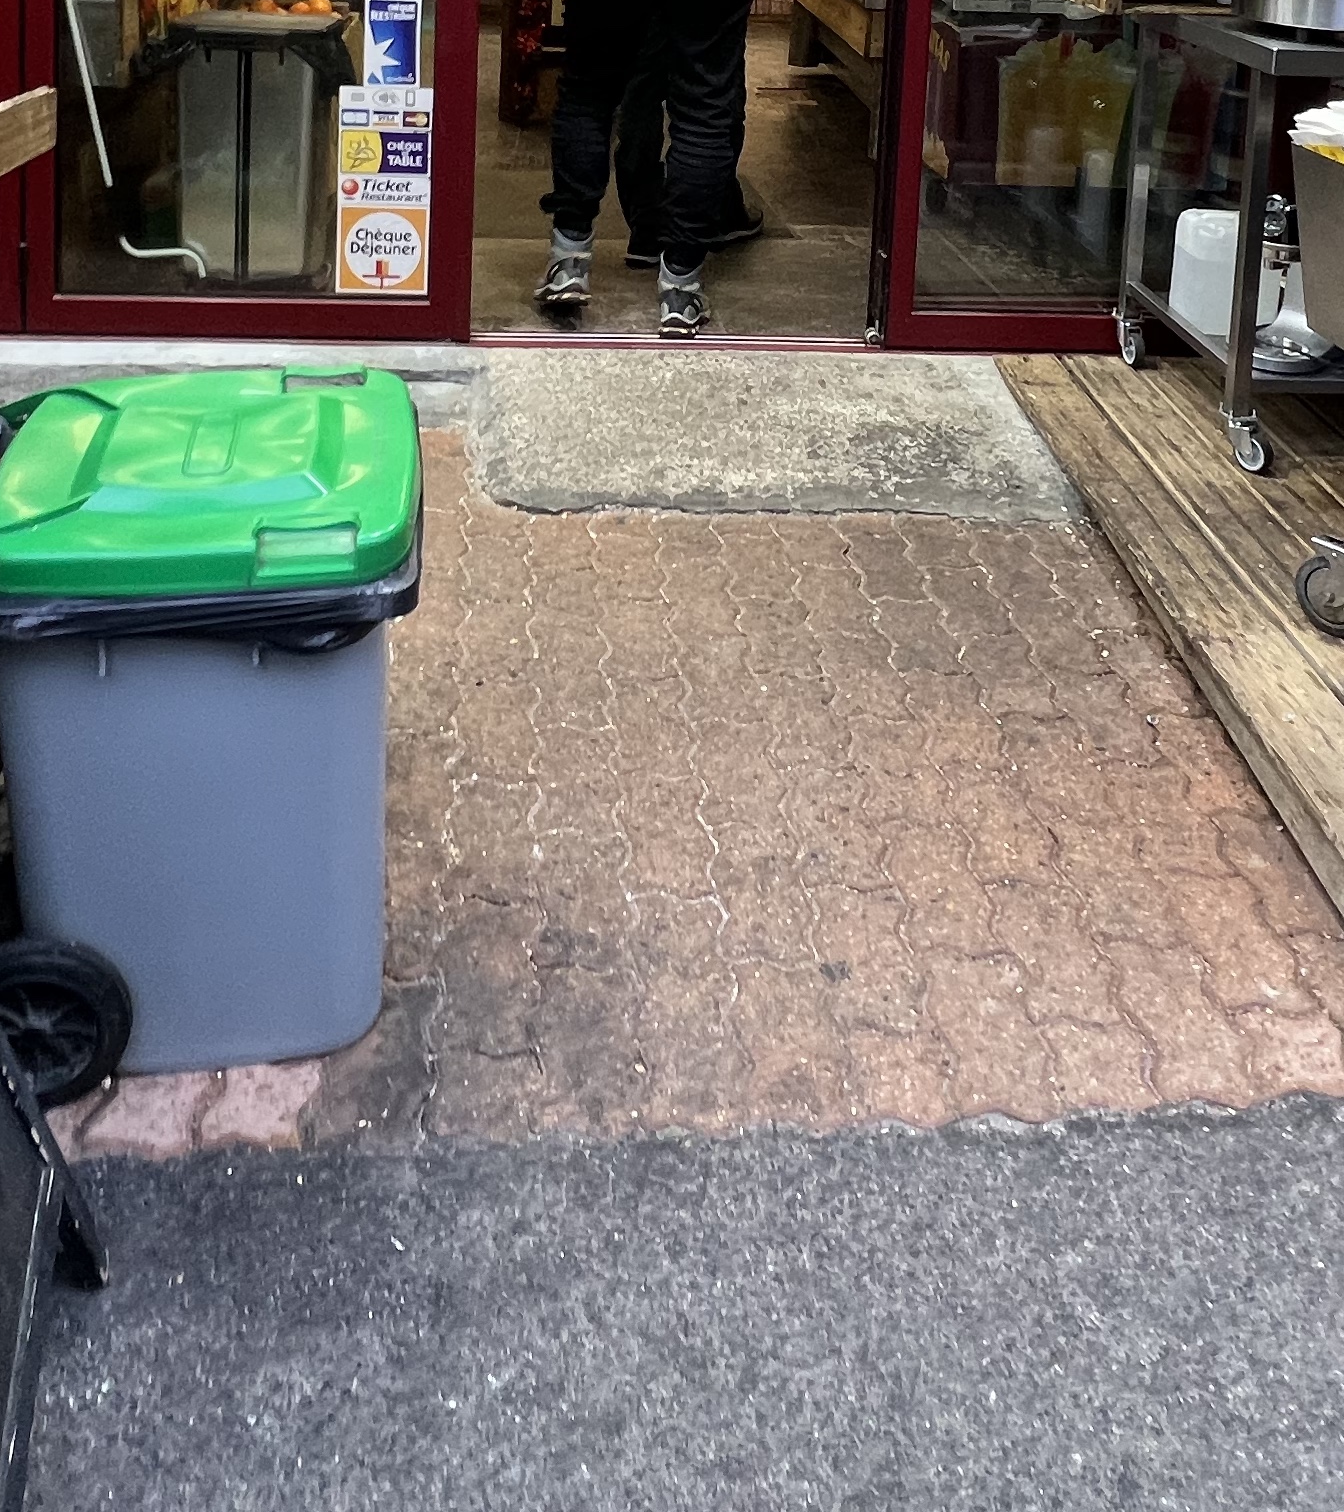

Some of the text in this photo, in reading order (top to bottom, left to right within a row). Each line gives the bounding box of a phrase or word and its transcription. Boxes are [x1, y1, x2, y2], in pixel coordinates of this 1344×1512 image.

[386, 154, 423, 167] TABLE
[362, 178, 414, 193] Ticket
[355, 226, 413, 245] Chèque
[349, 240, 418, 258] Déjeuner
